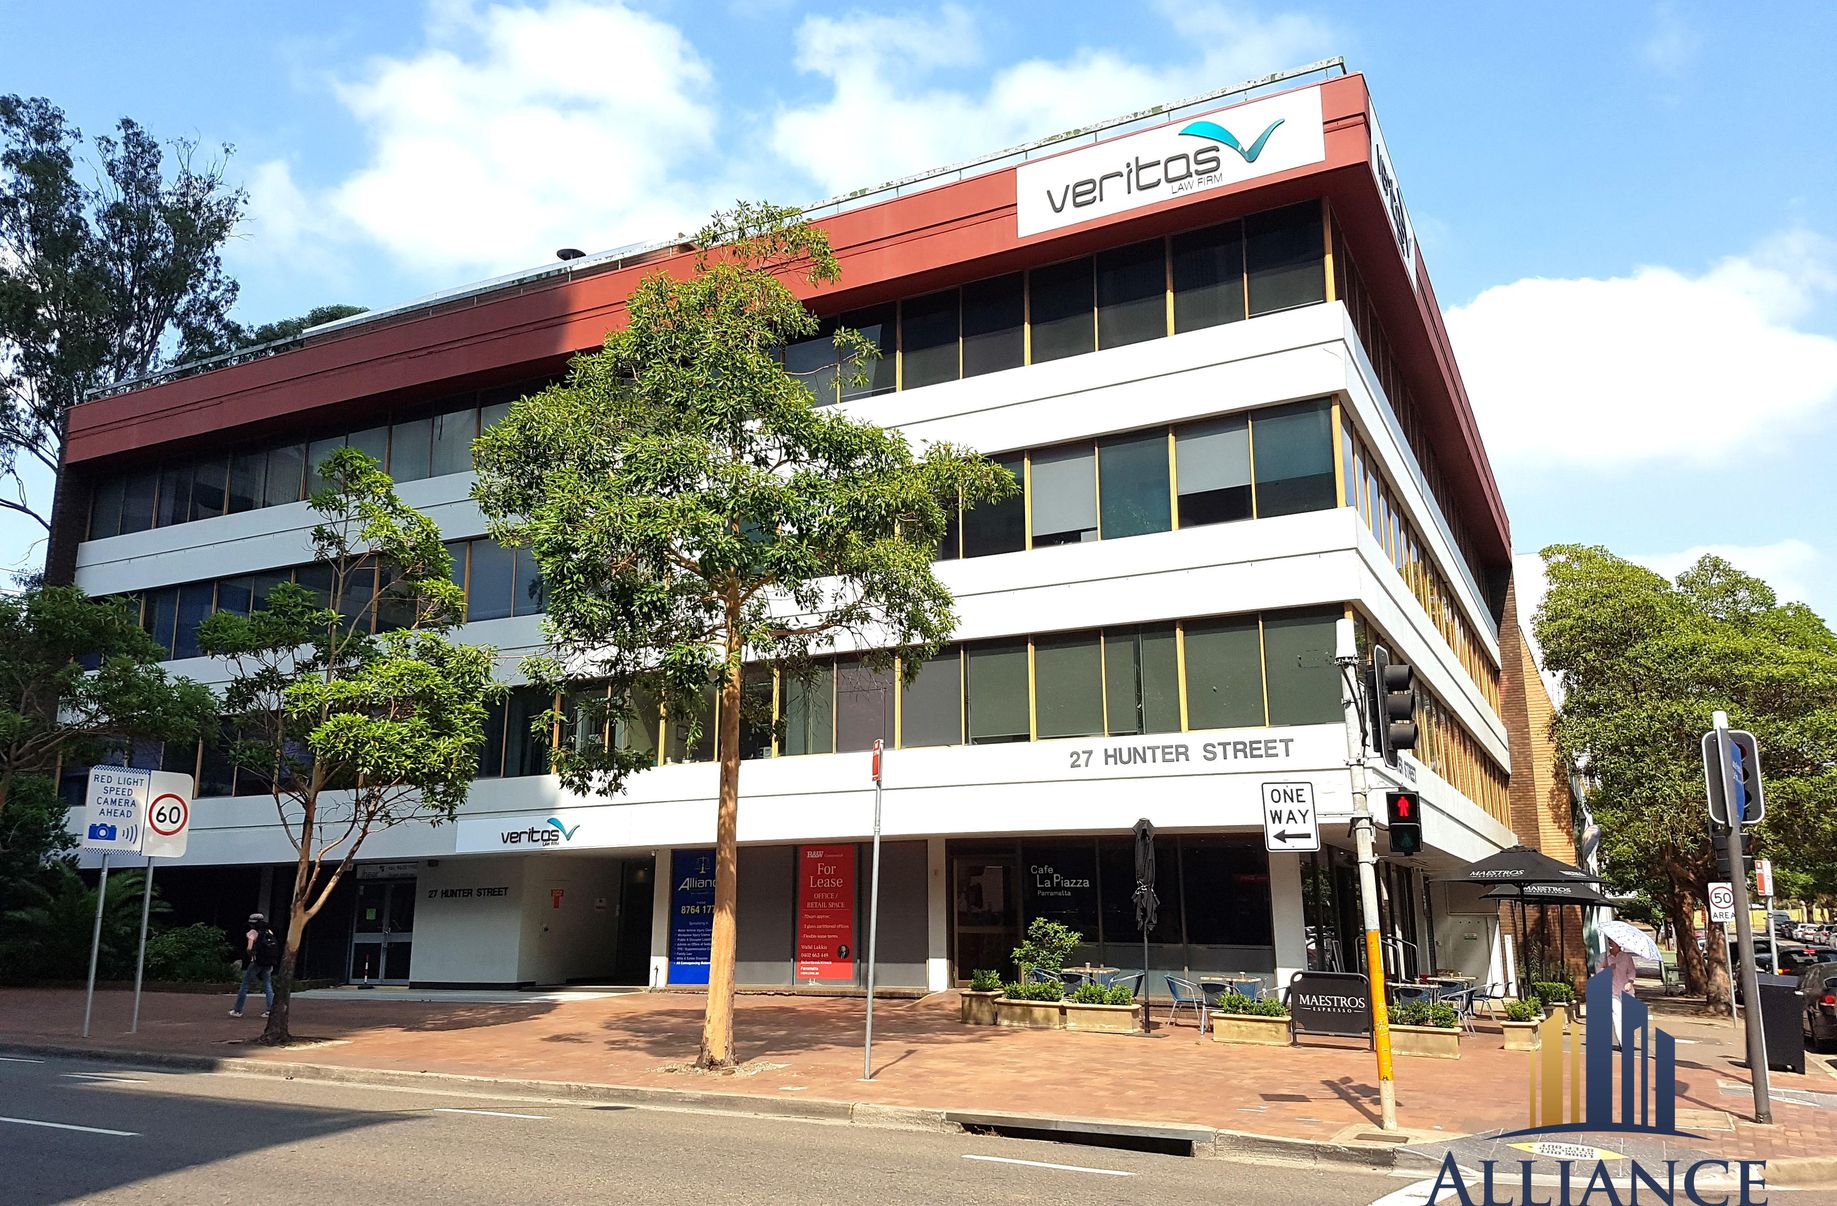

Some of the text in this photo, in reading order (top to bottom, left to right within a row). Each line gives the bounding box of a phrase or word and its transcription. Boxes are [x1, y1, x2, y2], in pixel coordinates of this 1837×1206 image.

[1046, 145, 1221, 213] veritas
[1171, 173, 1224, 195] LAW FIRM
[1069, 738, 1294, 769] 27 HUNTER STREET
[93, 774, 144, 787] RED LIGHT
[103, 786, 133, 797] SPEED
[1270, 788, 1306, 803] ONE
[96, 797, 137, 808] CAMERA
[98, 808, 133, 818] AHEAD
[156, 806, 181, 824] 60
[1270, 809, 1310, 825] WAY
[501, 826, 560, 844] veritas
[817, 862, 837, 875] For
[1030, 864, 1054, 875] Cafe
[678, 877, 717, 891] Allianc
[810, 876, 843, 888] Lease
[1036, 873, 1090, 888] La Piazza
[428, 887, 509, 898] 27 HUNTER STREET
[1037, 889, 1072, 897] Parramatta
[1523, 885, 1572, 893] MAESTROS
[1714, 892, 1732, 904] 50
[681, 904, 716, 915] 8764 177
[807, 901, 827, 909] RETAIL
[1713, 911, 1736, 920] AREA
[1298, 993, 1366, 1009] MAESTROS
